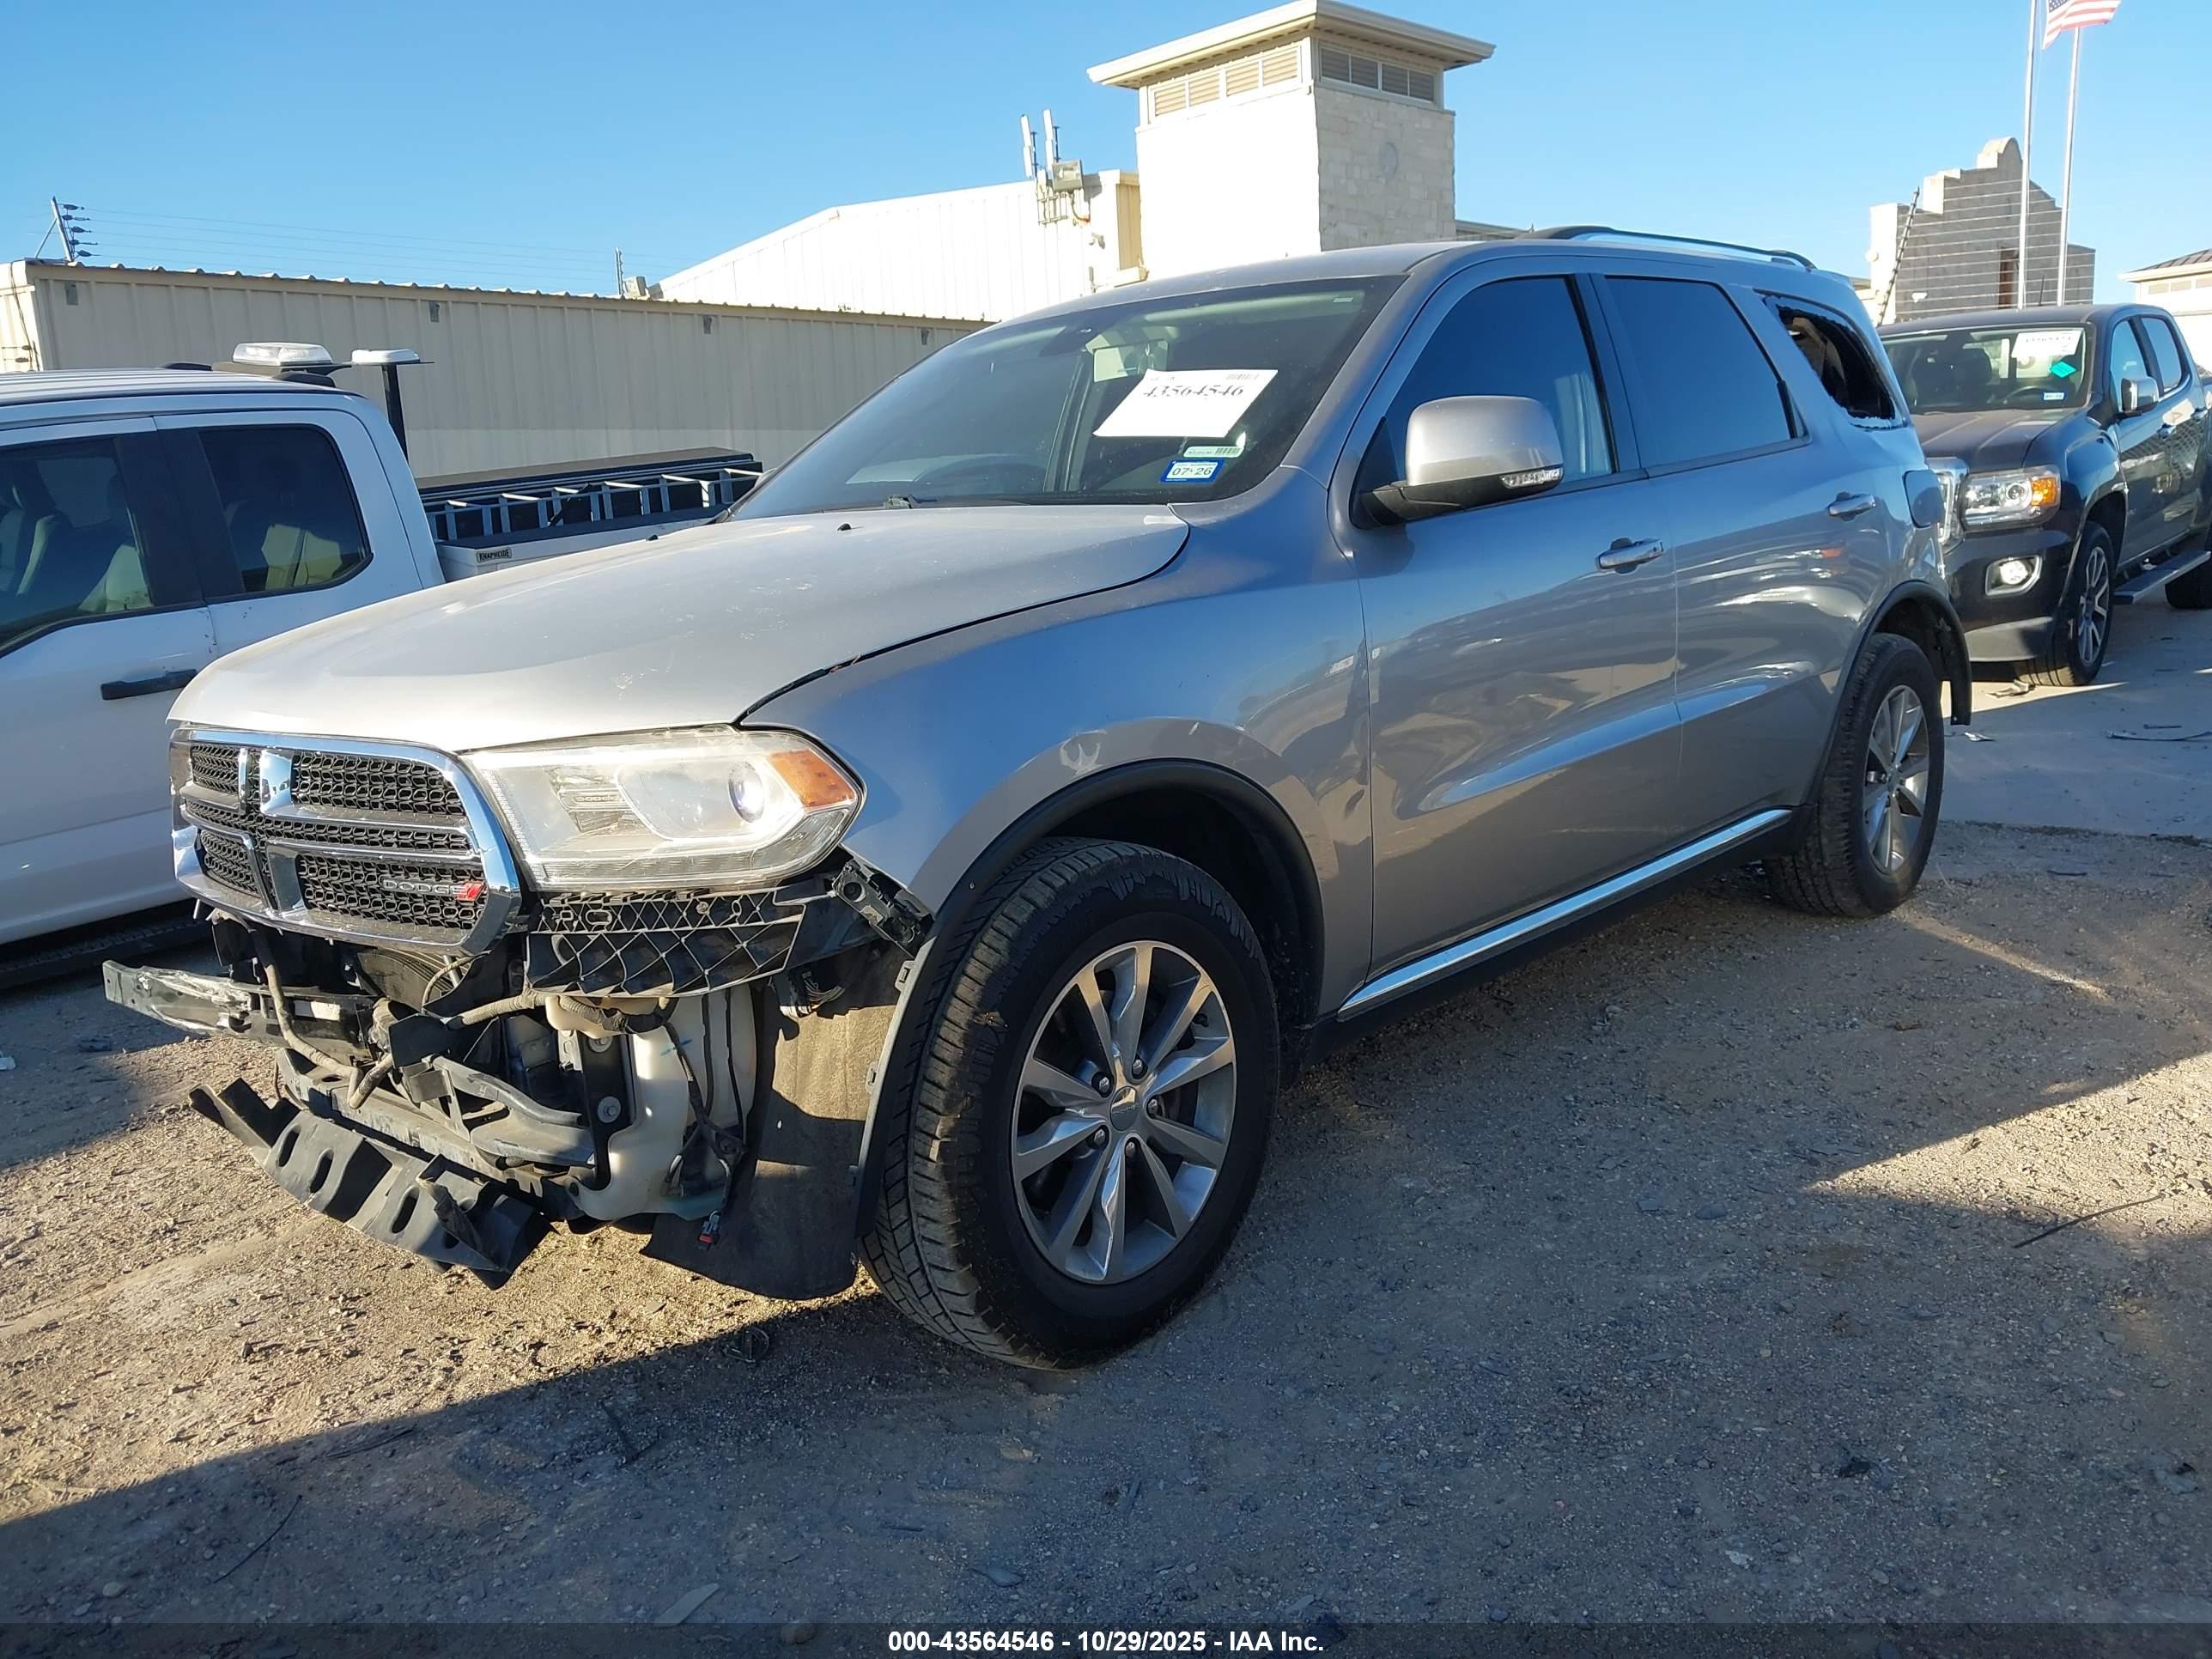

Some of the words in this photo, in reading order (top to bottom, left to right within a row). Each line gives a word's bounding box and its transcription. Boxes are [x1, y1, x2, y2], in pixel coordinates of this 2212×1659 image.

[1171, 466, 1190, 476] 07
[1194, 466, 1213, 476] 26
[383, 878, 467, 896] DODGE
